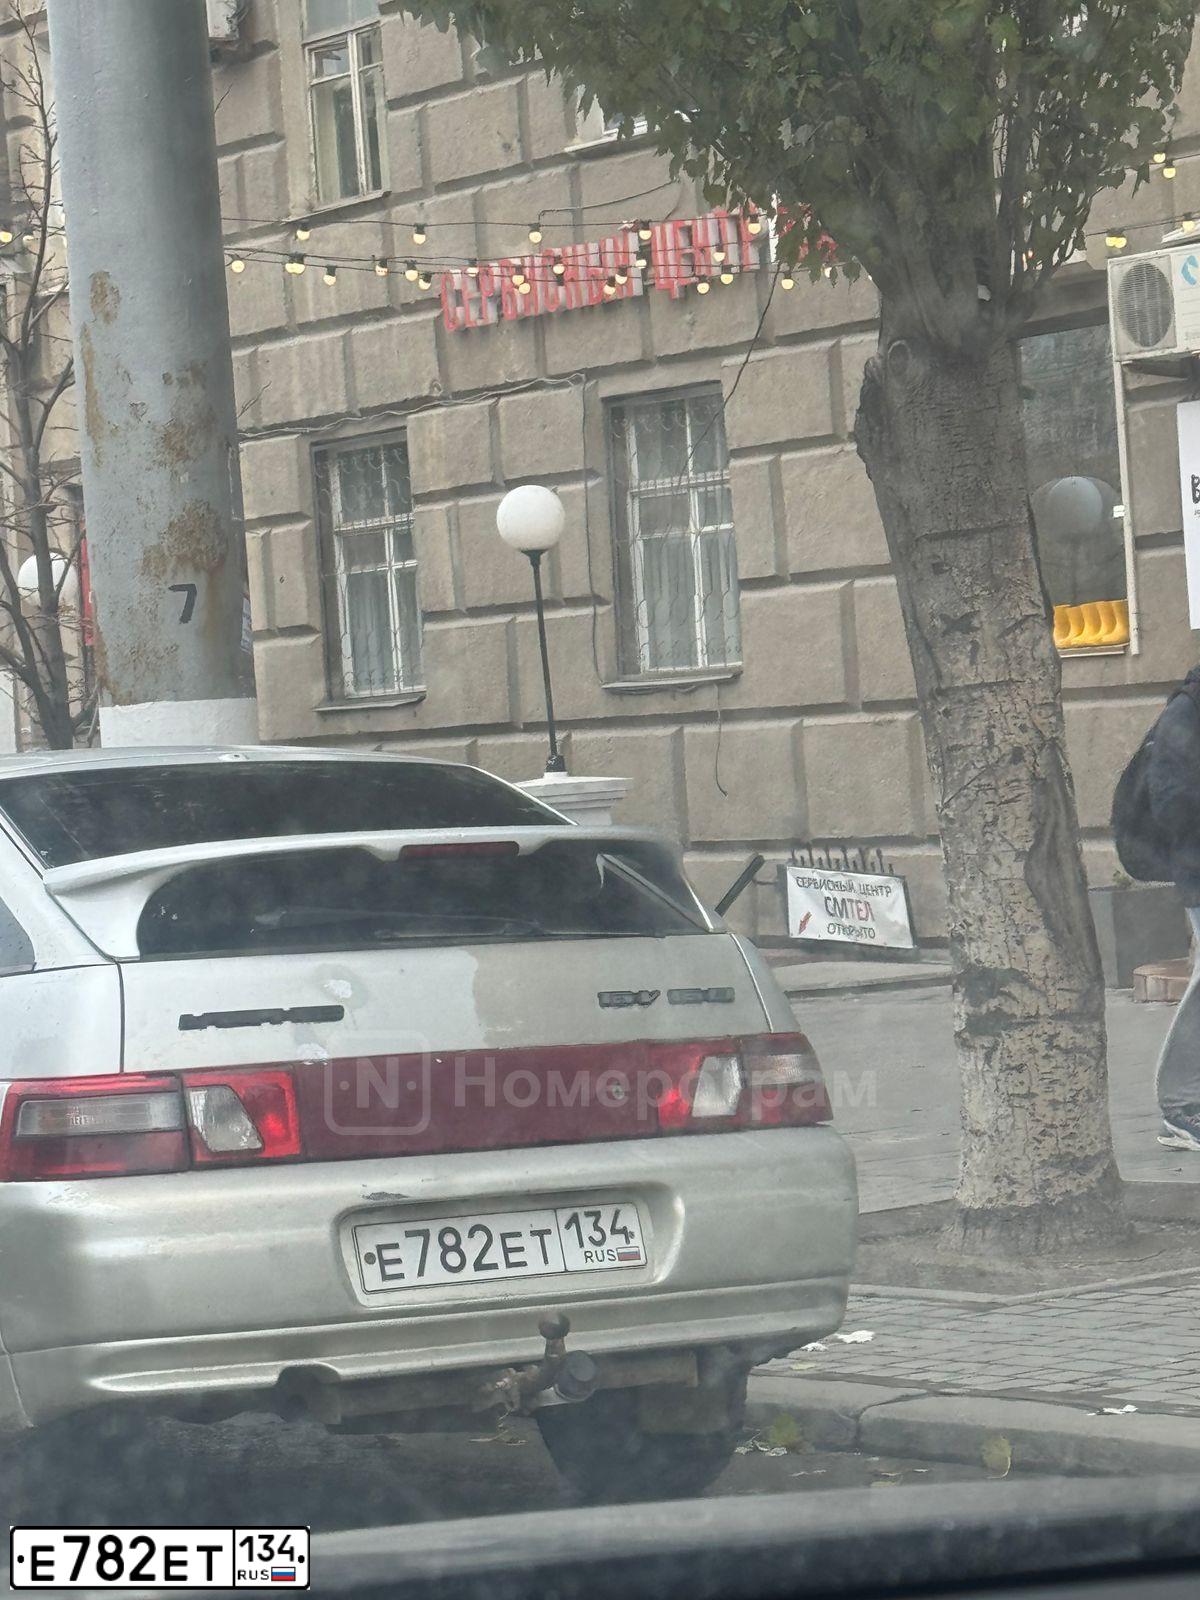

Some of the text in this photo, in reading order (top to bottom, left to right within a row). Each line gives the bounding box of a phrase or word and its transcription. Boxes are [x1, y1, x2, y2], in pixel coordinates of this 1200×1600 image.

[441, 220, 643, 332] СЕРВИСНЫЙ
[168, 583, 197, 624] 7
[796, 876, 892, 897] СЕРВИСНЫЙ ЦЕНТР
[827, 922, 876, 939] ОТКРЫТО
[564, 1209, 632, 1248] 134
[584, 1250, 617, 1263] RUS
